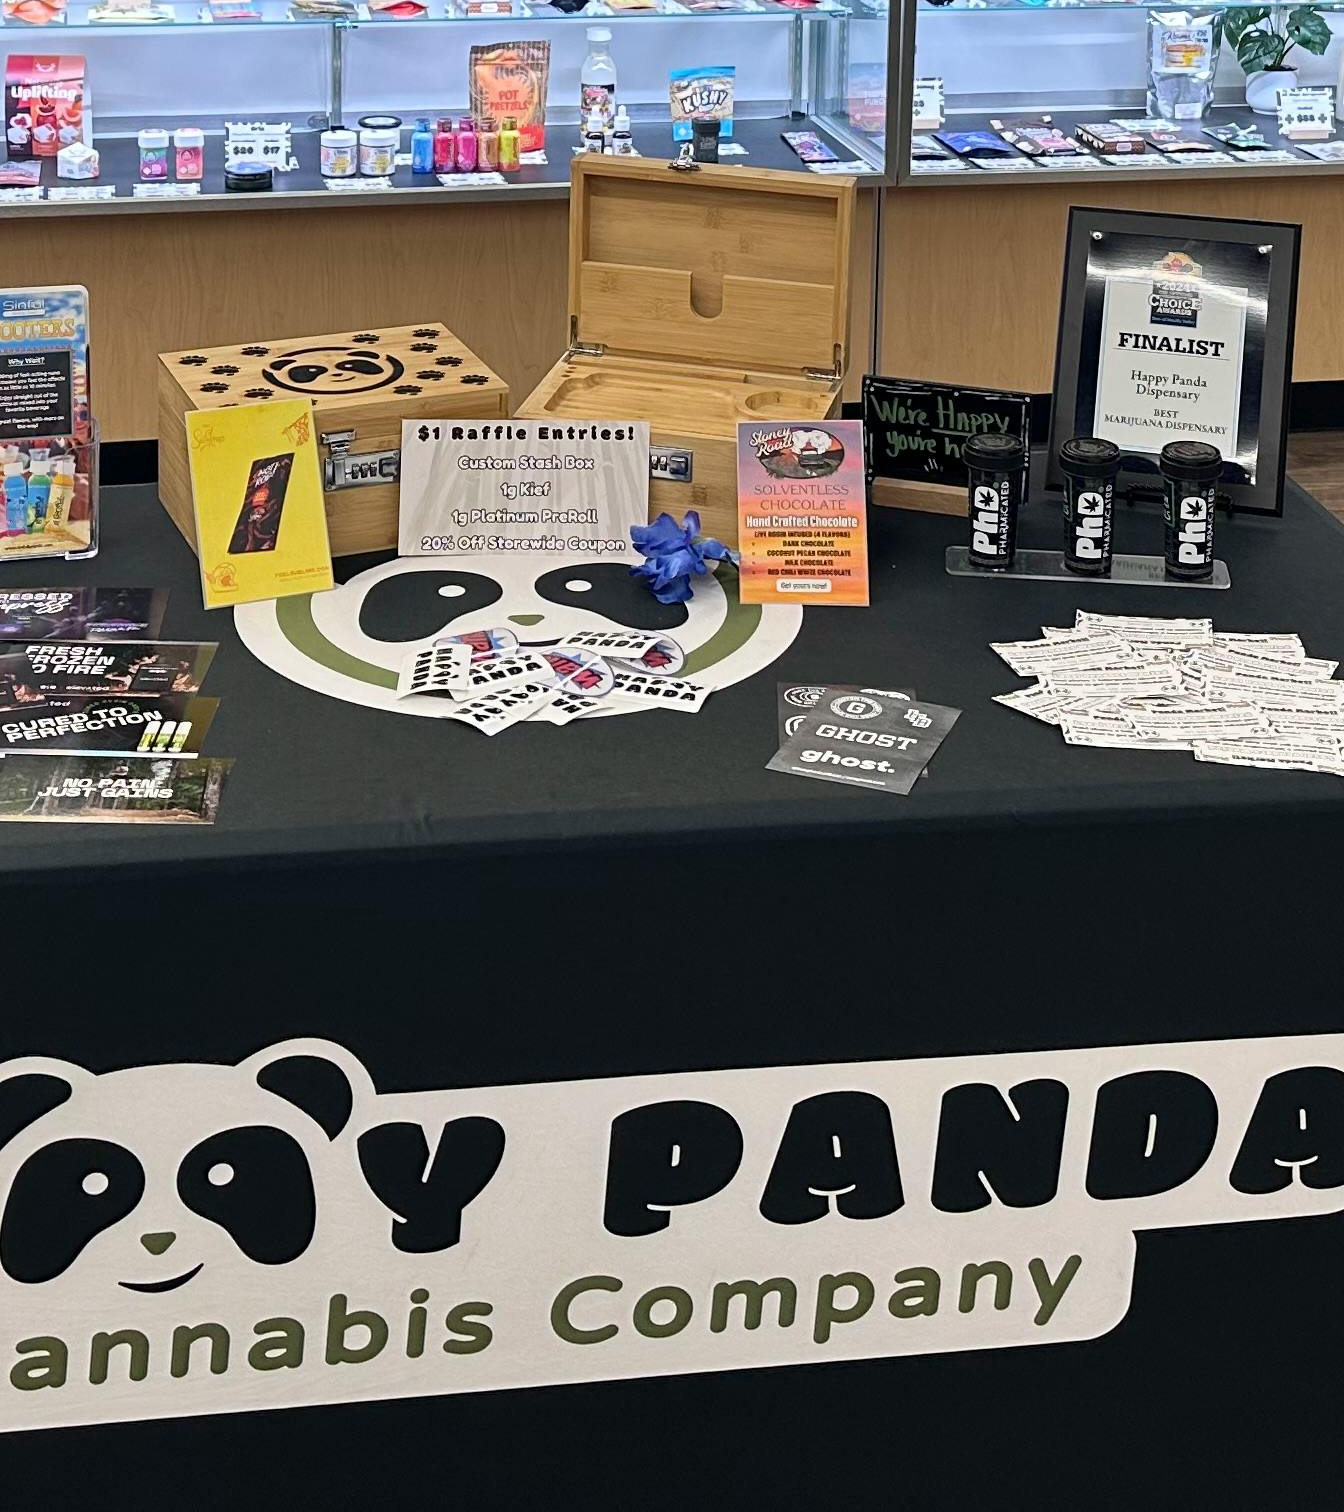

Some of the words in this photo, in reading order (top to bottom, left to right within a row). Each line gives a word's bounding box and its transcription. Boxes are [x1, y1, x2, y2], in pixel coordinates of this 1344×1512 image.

[10, 85, 78, 102] Uplifting
[498, 89, 519, 101] POT
[681, 88, 728, 114] KUSHY
[490, 101, 529, 112] PRETZELS
[2, 299, 45, 311] Sinful
[1148, 294, 1202, 310] CHOICE
[1118, 332, 1225, 357] FINALIST
[1131, 369, 1169, 386] Happy
[1172, 374, 1207, 388] Panda
[1136, 384, 1201, 403] Dispensary
[870, 394, 929, 426] We're
[1154, 408, 1179, 419] BEST
[1104, 414, 1163, 429] MARIJUANA
[1165, 420, 1228, 435] DISPENSARY
[417, 425, 441, 443] $1
[451, 426, 527, 441] Raffle
[538, 425, 635, 441] Entries!
[749, 427, 792, 447] Stoney
[458, 455, 516, 470] Custom
[518, 455, 561, 470] Stash
[564, 456, 594, 470] Box
[500, 482, 517, 500] 1g
[519, 481, 552, 497] Kief
[754, 484, 849, 495] SOLVENTLESS
[760, 500, 846, 510] CHOCOLATE
[451, 509, 469, 527] 1g
[470, 509, 539, 525] Platinum
[541, 509, 598, 524] PreRoll
[746, 515, 773, 528] Hand
[773, 515, 809, 528] Crafted
[810, 516, 858, 528] Chocolate
[421, 536, 455, 551] 20%
[457, 536, 486, 551] Off
[487, 537, 565, 552] Storewide
[567, 538, 626, 554] Coupon
[25, 645, 104, 656] FRESH
[58, 665, 108, 675] FIRE
[1, 711, 89, 734] CURED
[5, 710, 163, 744] PERFECTION
[815, 724, 918, 751] GHOST
[799, 749, 895, 774] ghost.
[62, 778, 93, 789] NO
[37, 788, 98, 798] JUST
[100, 788, 173, 799] GAINS
[548, 1252, 1082, 1348] Company
